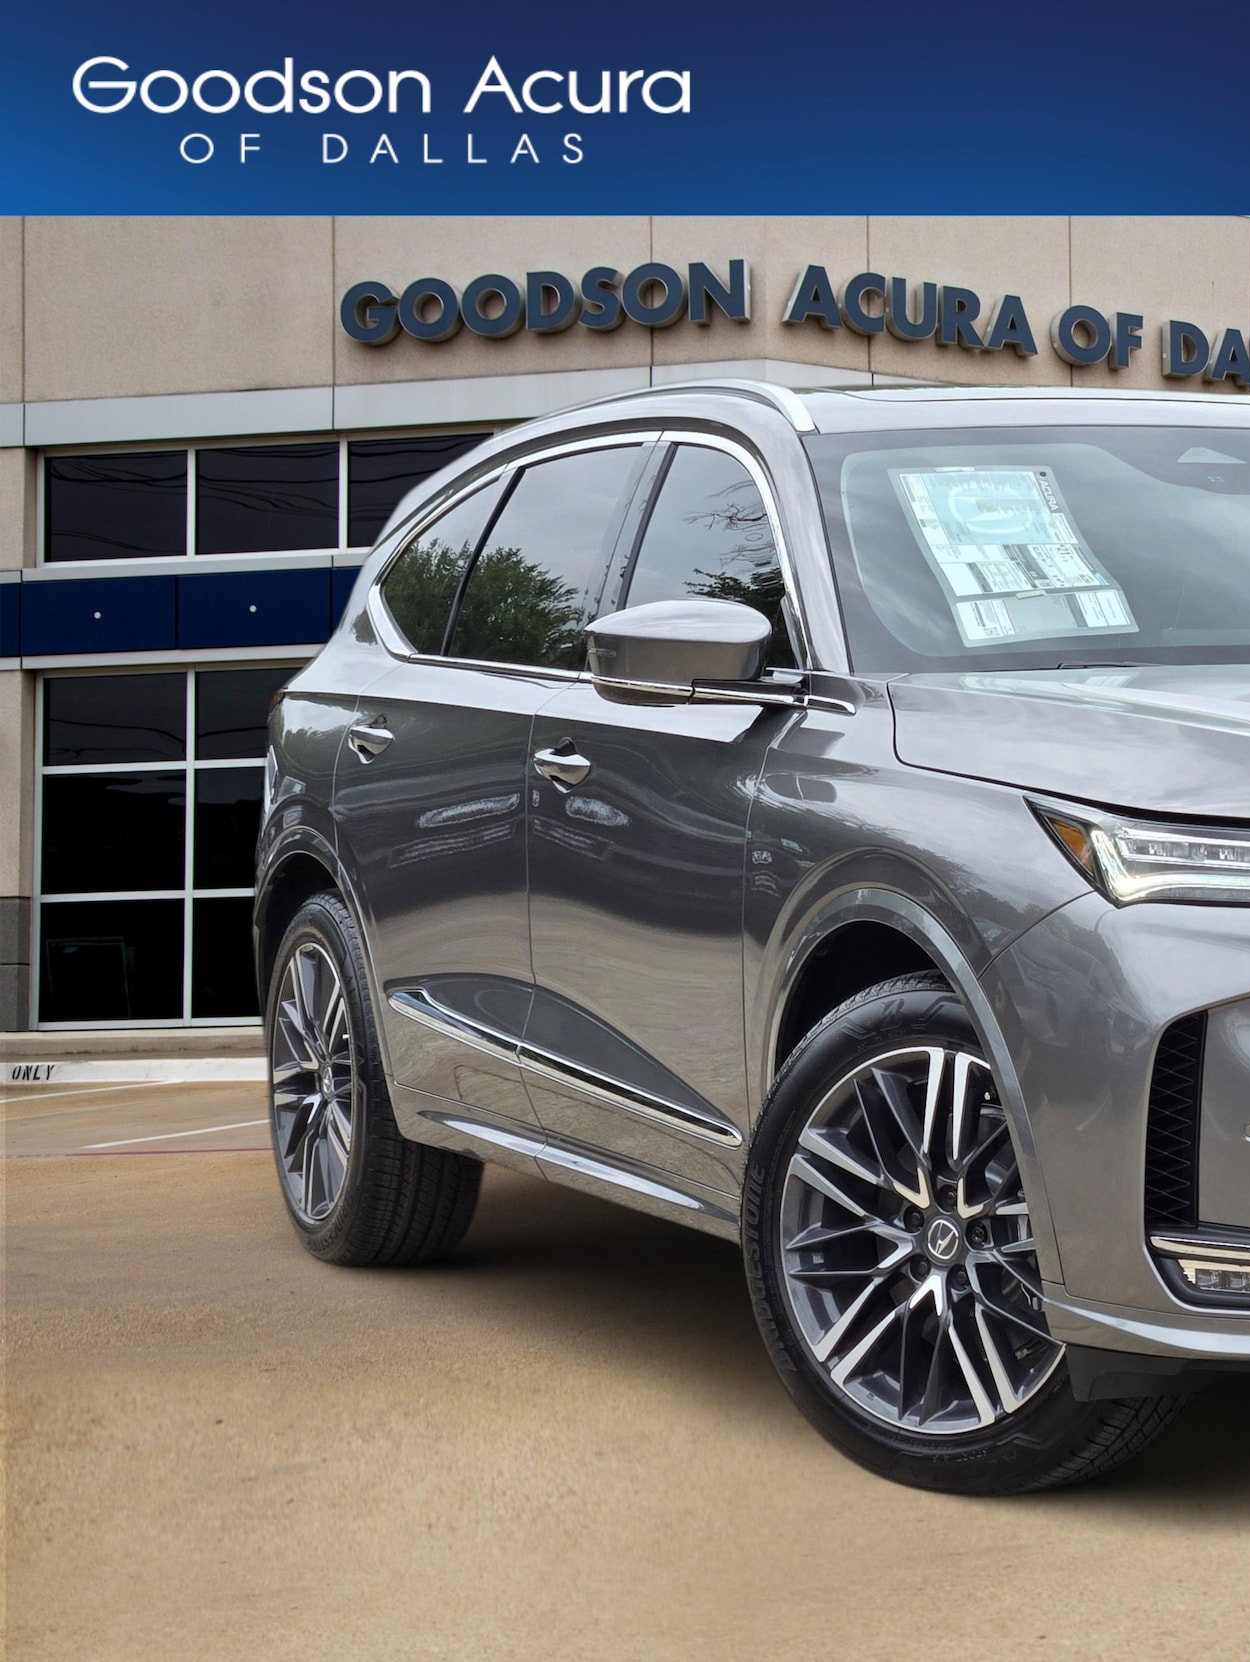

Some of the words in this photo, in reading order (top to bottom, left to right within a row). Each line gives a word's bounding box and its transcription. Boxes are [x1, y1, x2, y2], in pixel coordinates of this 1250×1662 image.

[341, 259, 752, 345] GOODSON
[783, 264, 1038, 356] ACURA
[1052, 304, 1144, 368] OF
[1040, 480, 1059, 511] ACURA
[11, 1064, 55, 1081] ONLY
